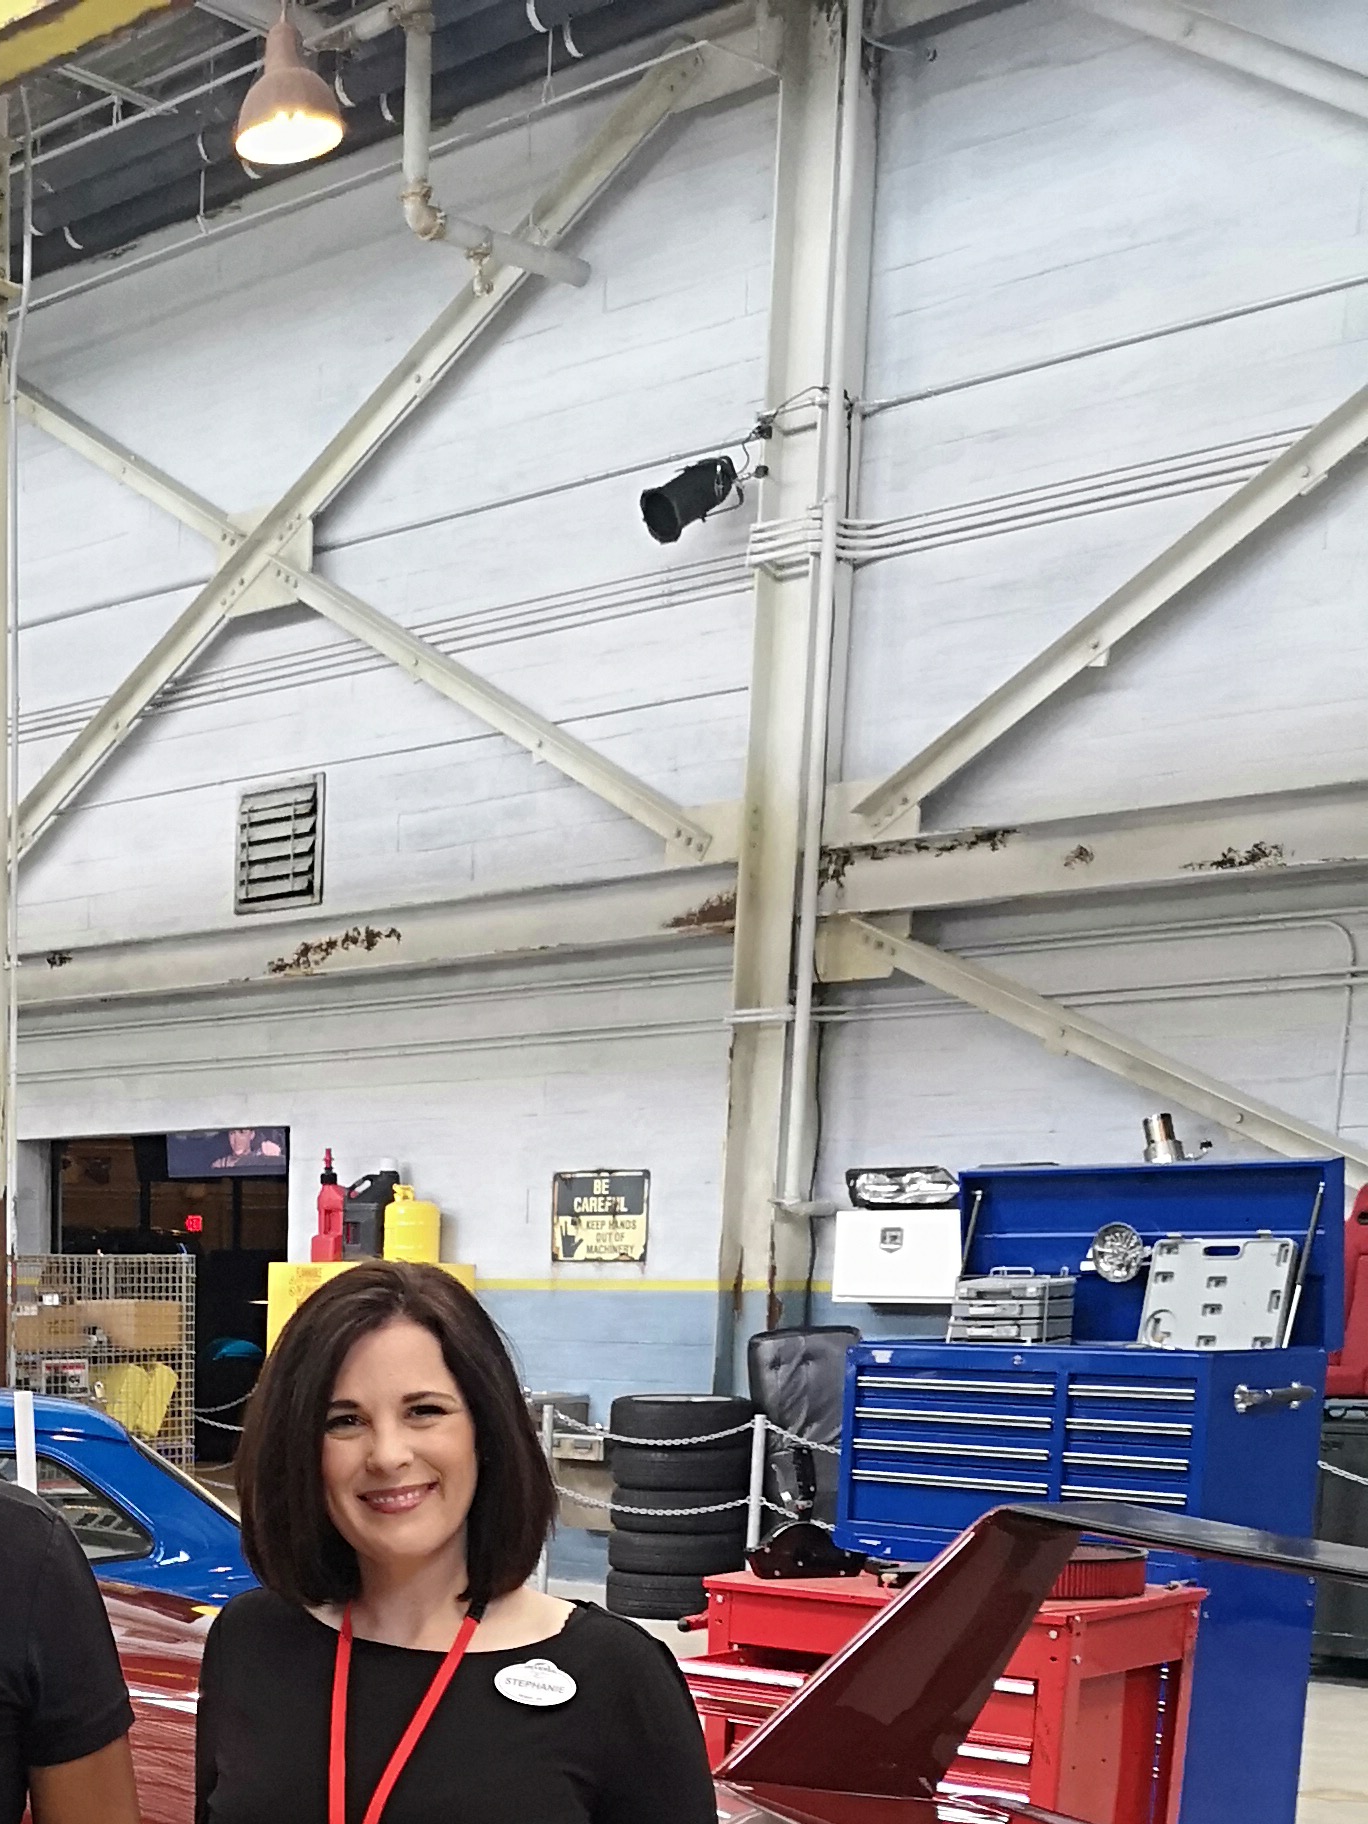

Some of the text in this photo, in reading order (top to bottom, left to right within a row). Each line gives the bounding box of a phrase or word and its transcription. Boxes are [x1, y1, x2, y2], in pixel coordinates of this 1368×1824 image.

[593, 1178, 610, 1195] BE
[585, 1219, 637, 1230] KEEP HANDS
[595, 1231, 625, 1243] OUT OF
[586, 1245, 634, 1255] MACHINERY
